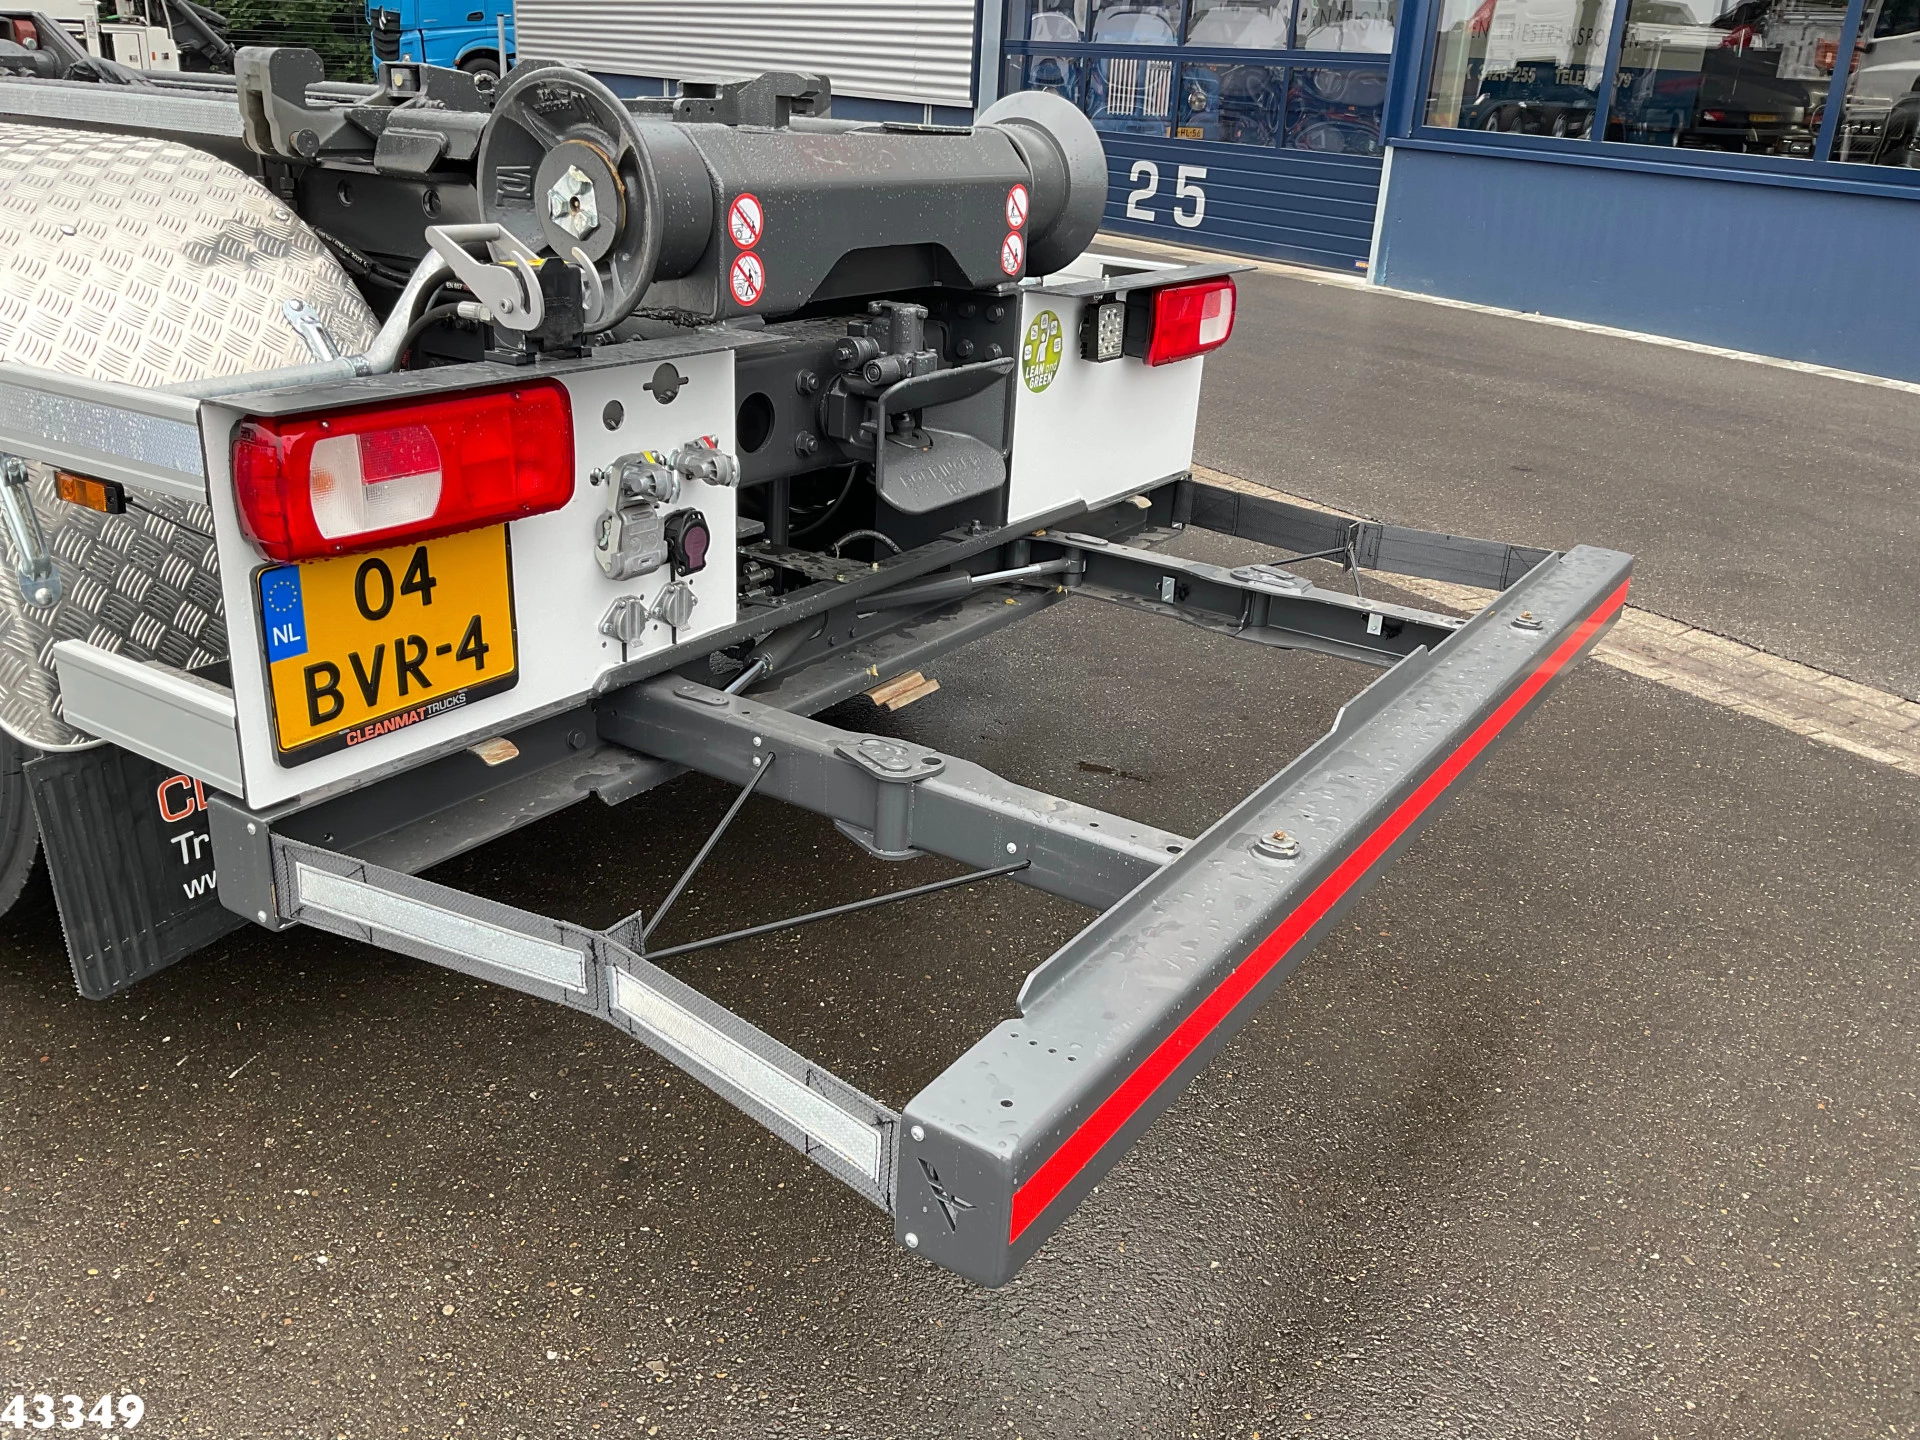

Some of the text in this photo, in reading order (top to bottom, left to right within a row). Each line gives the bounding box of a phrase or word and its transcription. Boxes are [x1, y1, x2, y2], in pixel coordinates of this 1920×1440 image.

[1127, 160, 1207, 228] 25
[1025, 362, 1045, 379] LEAN
[1029, 372, 1053, 389] GREEN
[354, 545, 437, 621] 04
[272, 623, 300, 646] NL
[303, 614, 490, 727] BVR-4
